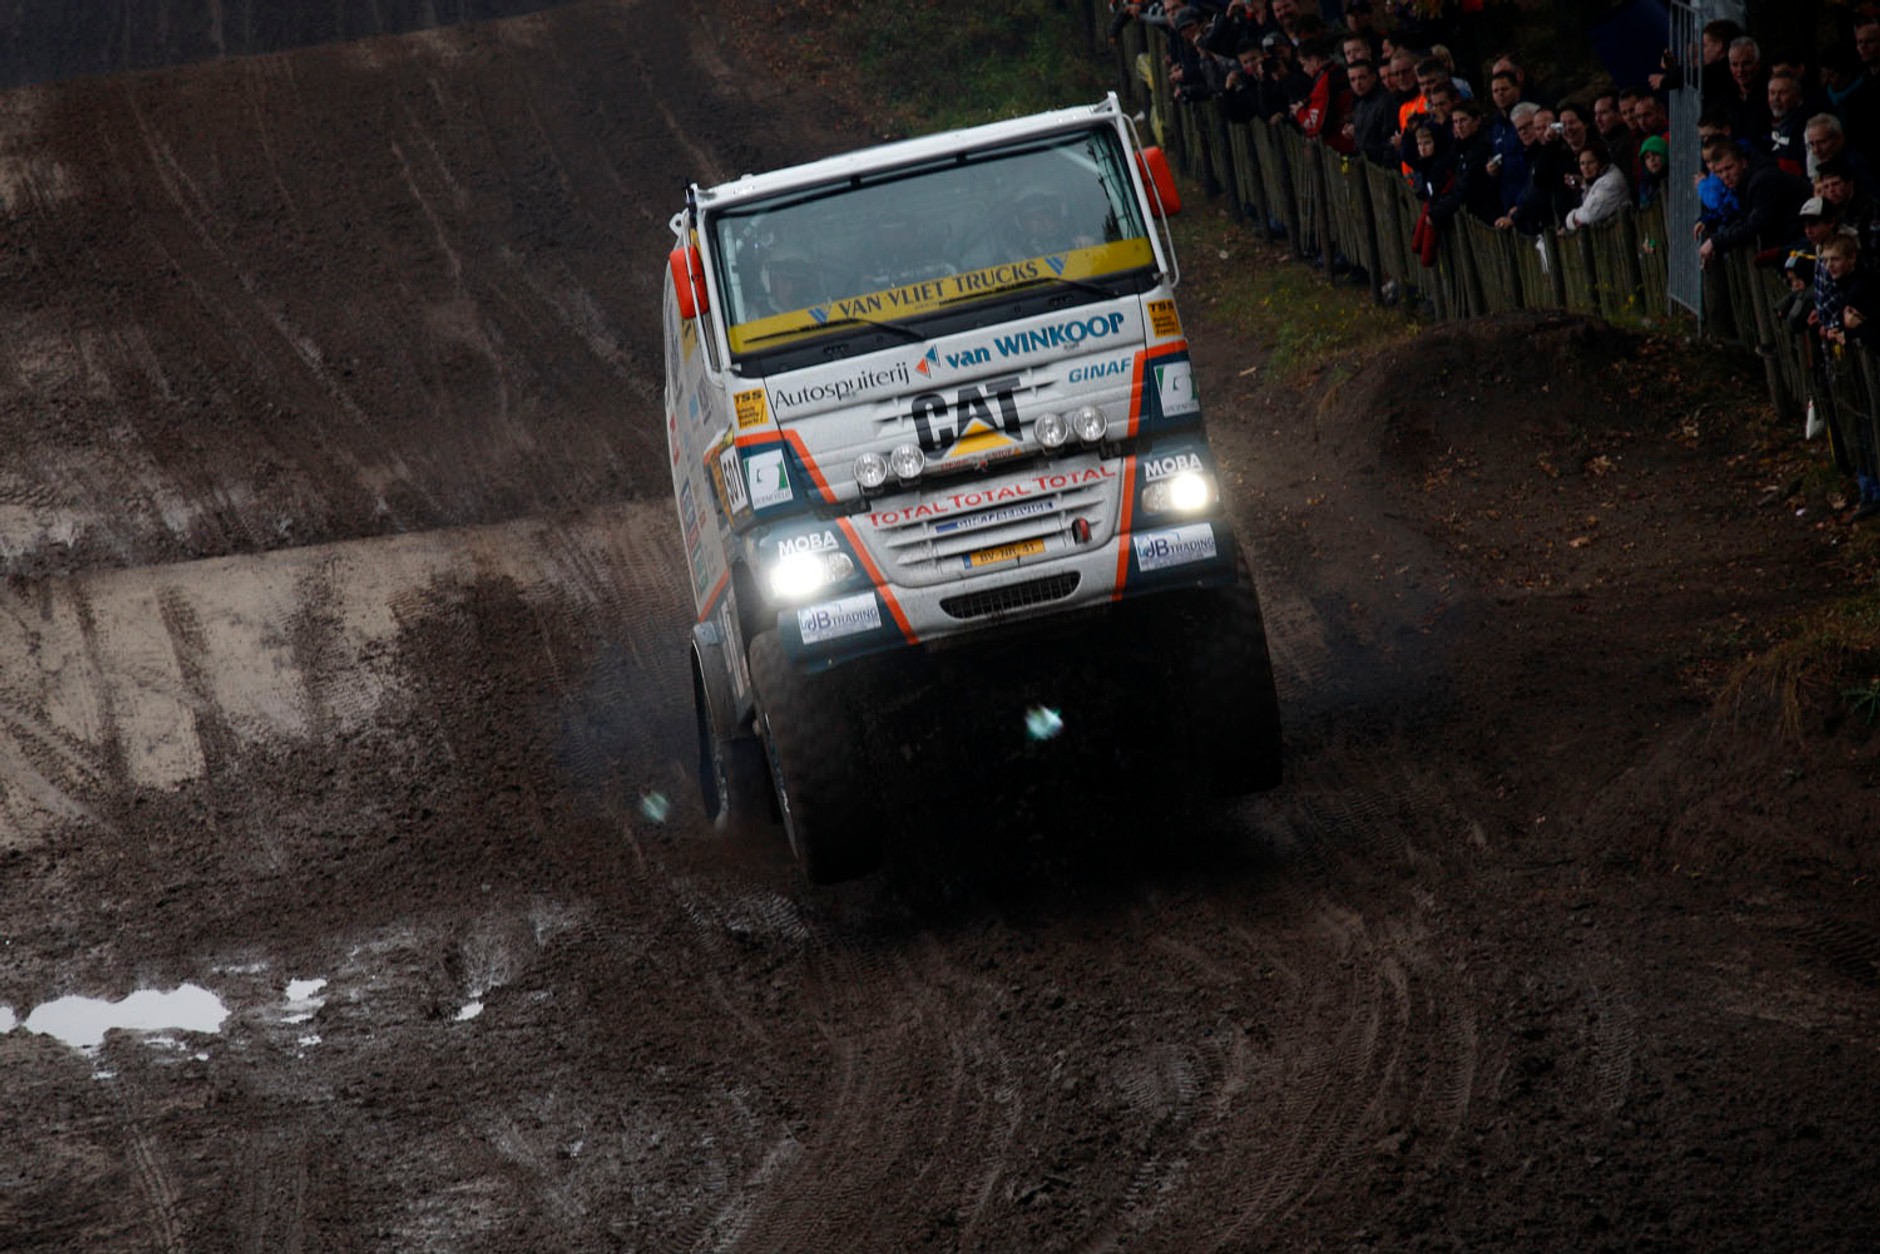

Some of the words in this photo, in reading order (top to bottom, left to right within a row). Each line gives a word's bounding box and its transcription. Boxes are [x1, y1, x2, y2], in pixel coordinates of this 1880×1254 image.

[838, 294, 882, 317] VAN
[887, 279, 944, 307] VLIET
[953, 261, 1039, 293] TRUCKS
[774, 361, 911, 411] Autospuiterij
[945, 346, 991, 369] van
[993, 311, 1125, 358] WINKOOP
[1068, 357, 1132, 383] GINAF
[733, 390, 763, 405] TSS
[911, 376, 1024, 460] CAT
[1143, 452, 1205, 480] MOBA
[865, 501, 948, 527] TOTAL
[948, 481, 1031, 509] TOTAL
[1032, 465, 1117, 492] TOTAL
[777, 529, 840, 557] MOBA
[1169, 537, 1215, 554] TRADING
[832, 607, 879, 626] TRADING
